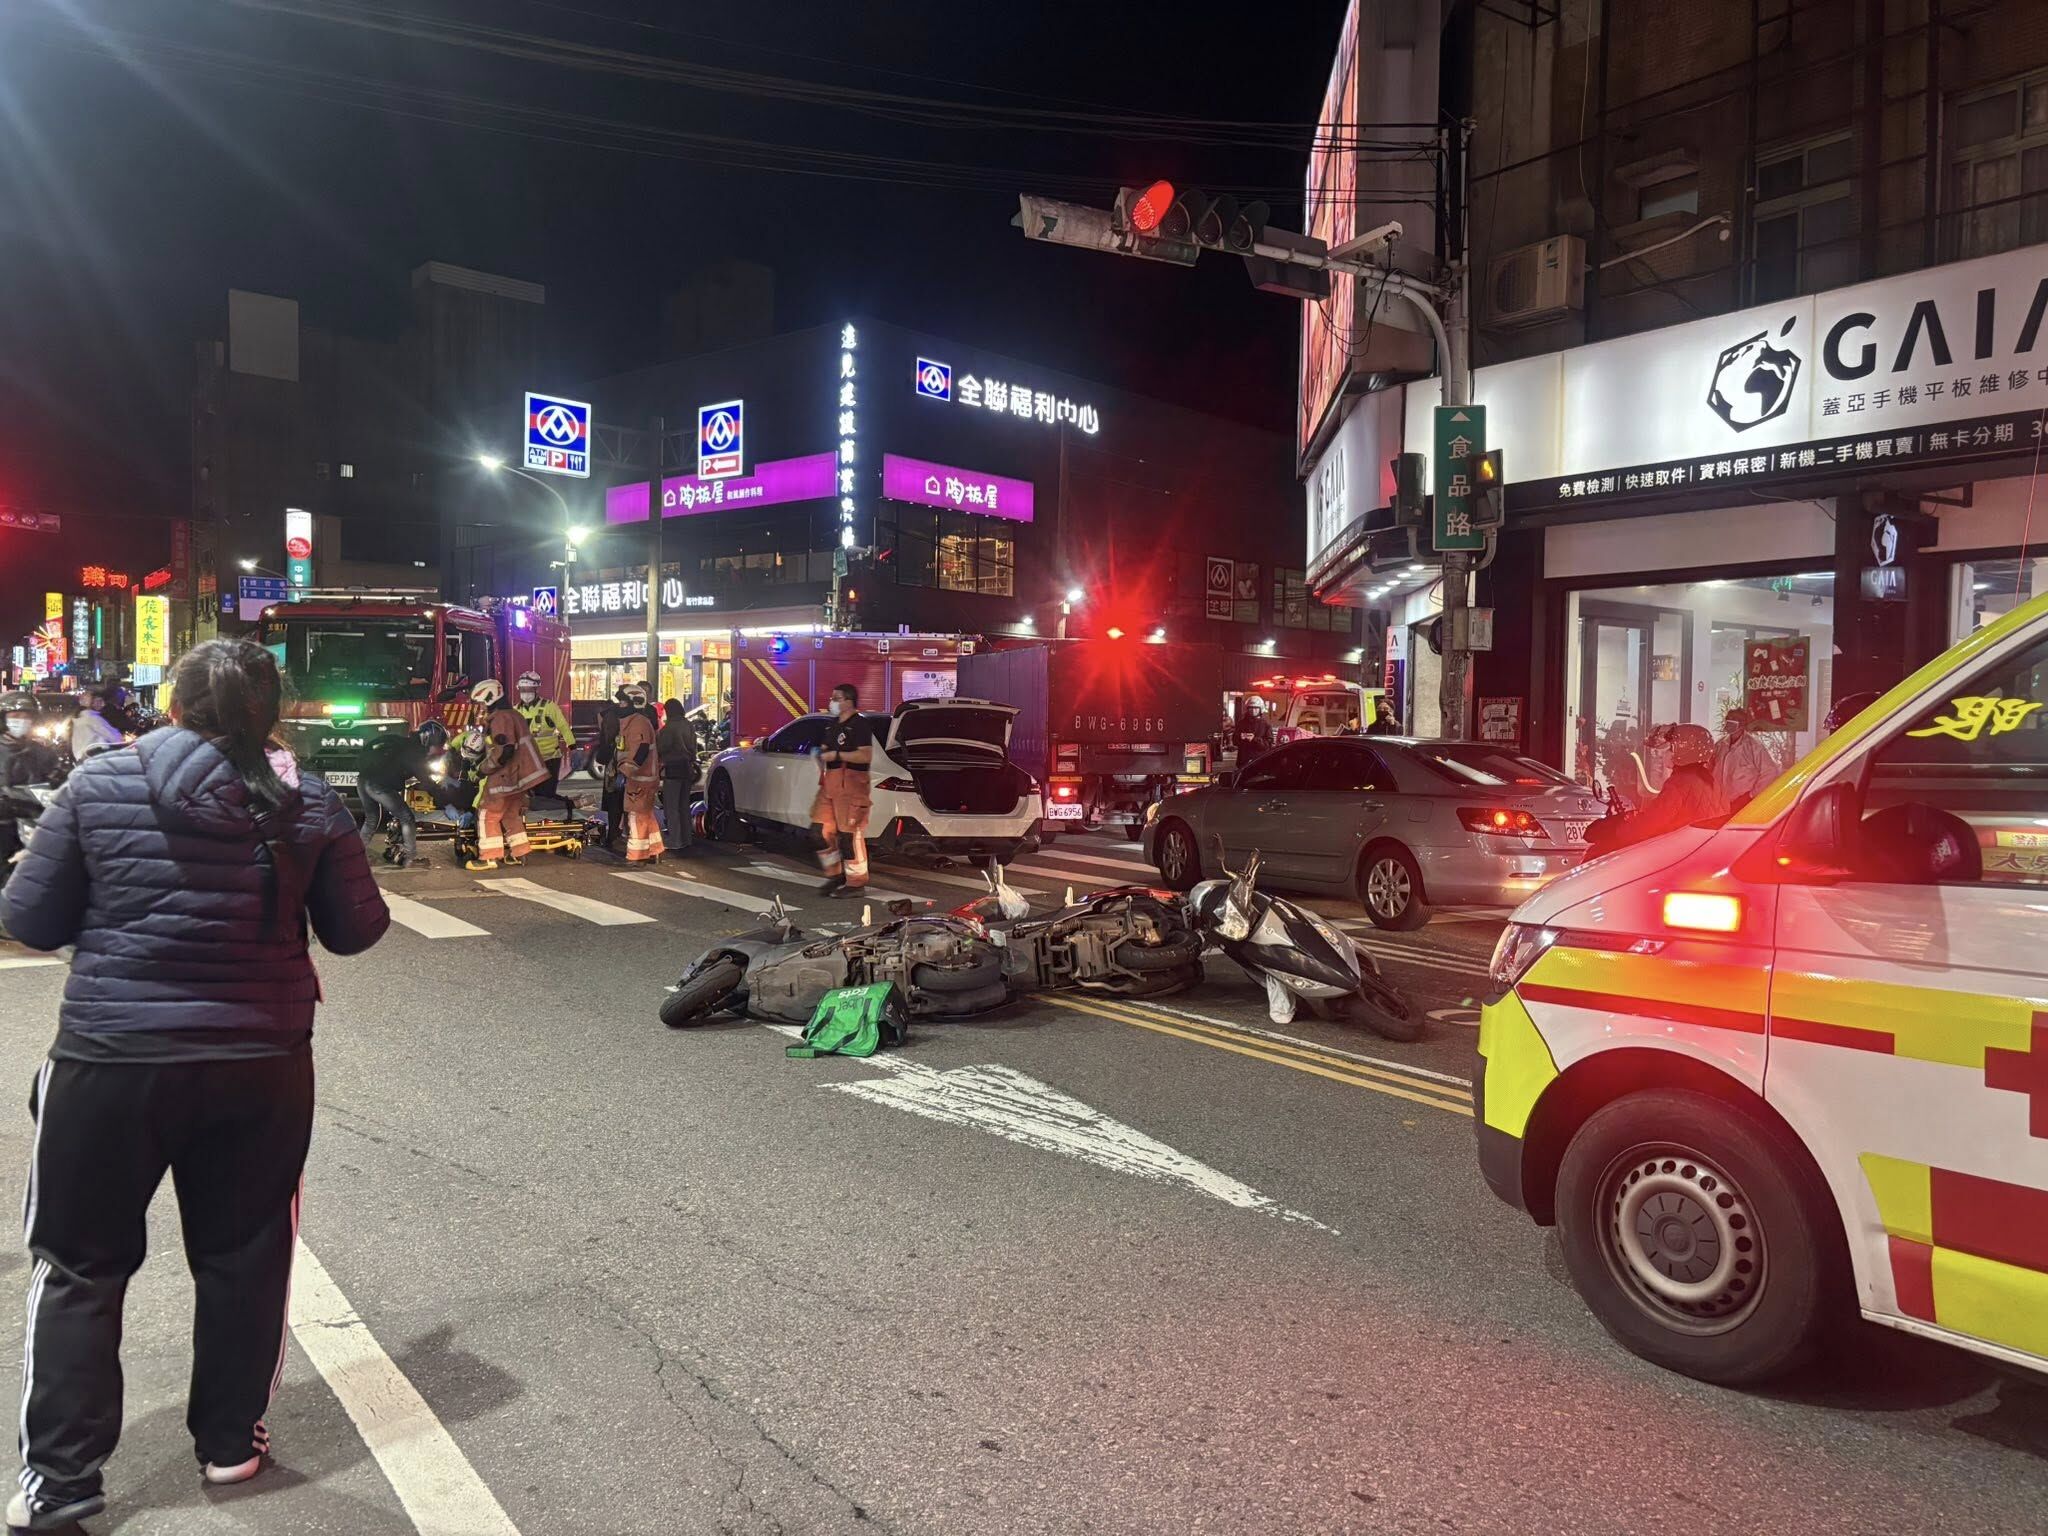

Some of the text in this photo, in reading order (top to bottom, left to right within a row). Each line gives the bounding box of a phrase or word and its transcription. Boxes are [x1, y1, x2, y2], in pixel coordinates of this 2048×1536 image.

[1823, 278, 2048, 381] GAIA
[958, 373, 1100, 434] 全聯福利中心
[529, 448, 547, 457] ATM
[551, 451, 564, 467] P
[1558, 476, 1614, 498] 免費檢測
[1625, 467, 1686, 490] 快速取件
[1699, 456, 1767, 481] 資料保密
[1779, 436, 1914, 470] 新機二手機買賣
[1929, 423, 2014, 450] 無卡分期
[702, 461, 711, 474] P
[679, 480, 724, 509] 陶板屋
[945, 476, 998, 509] 陶板屋
[1447, 435, 1472, 537] 食品路
[1870, 570, 1897, 587] GAIA
[1075, 715, 1164, 731] BWG-6956
[321, 738, 364, 747] MAN
[837, 987, 869, 999] Eats
